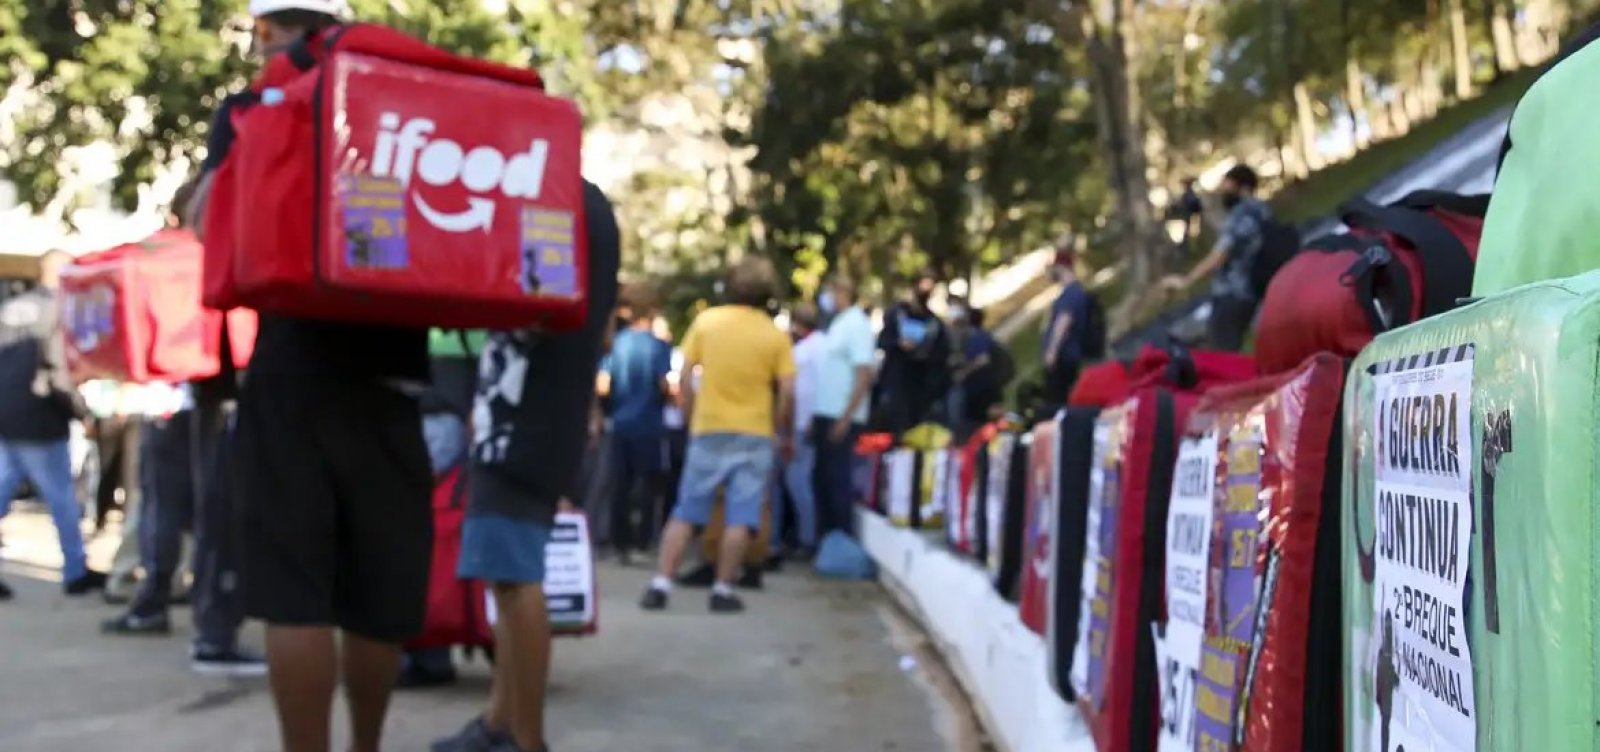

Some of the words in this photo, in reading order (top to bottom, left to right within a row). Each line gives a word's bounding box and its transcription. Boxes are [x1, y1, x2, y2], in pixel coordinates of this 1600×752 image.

[371, 111, 548, 198] ifood
[1389, 391, 1459, 475] GUERRA
[1380, 488, 1458, 585] CONTINUA
[1403, 585, 1460, 657] BREQUE
[1402, 642, 1470, 717] NACIONAL
